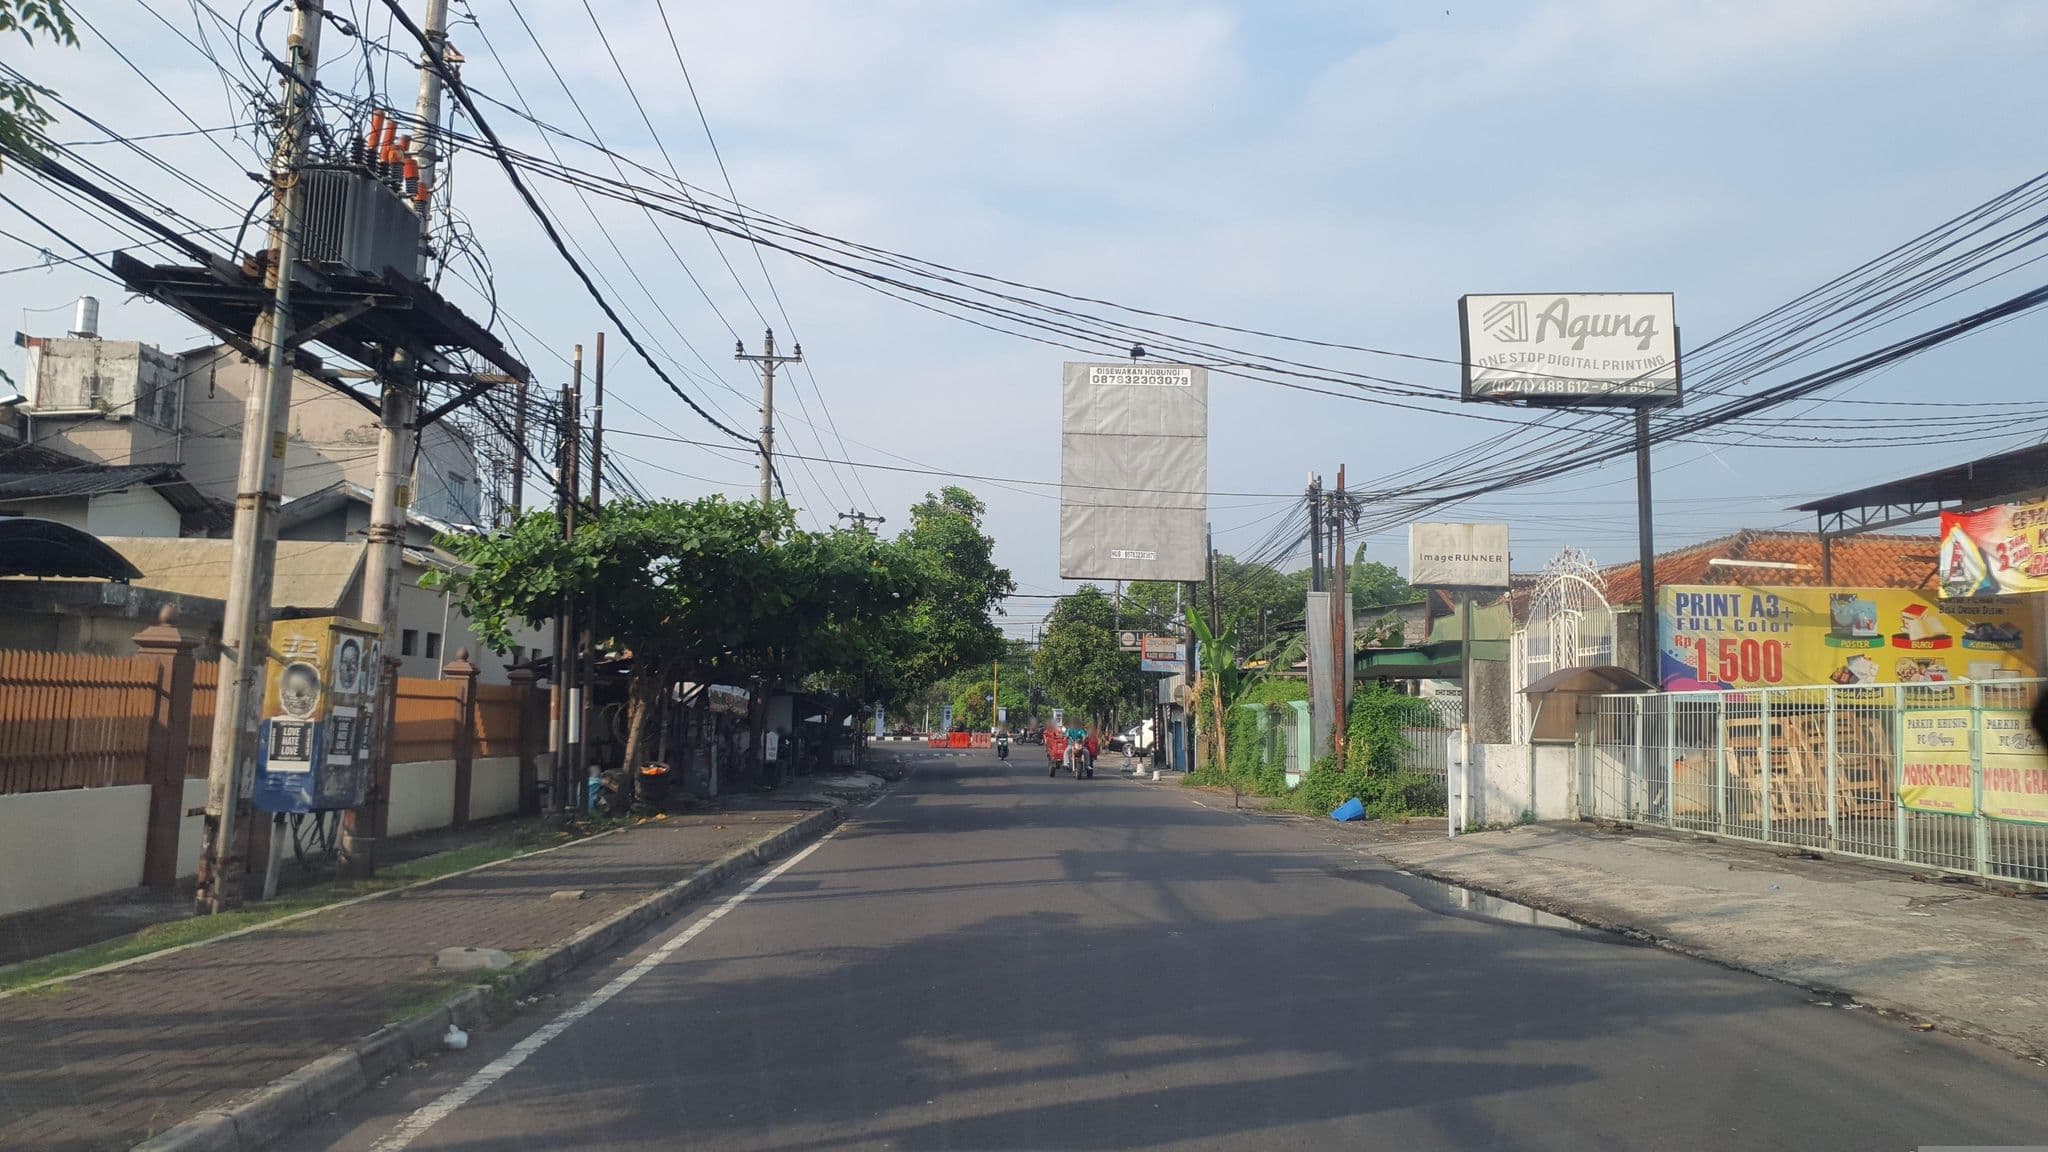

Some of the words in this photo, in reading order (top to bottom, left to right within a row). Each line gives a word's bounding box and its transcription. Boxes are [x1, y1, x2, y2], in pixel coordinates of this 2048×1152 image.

[1535, 297, 1659, 350] Agung
[1478, 353, 1507, 367] ONE
[1509, 352, 1545, 364] STOP
[1547, 354, 1600, 370] DIGITAL
[1605, 355, 1665, 371] PRINTING
[1097, 367, 1143, 375] DISEWAKAN
[1538, 380, 1567, 393] 488
[1567, 380, 1590, 393] 612
[1675, 593, 1741, 617] PRINT
[1750, 594, 1793, 618] A3+
[1677, 617, 1725, 631] FULL
[1734, 619, 1793, 632] Color
[1675, 634, 1692, 648] Rp
[1840, 640, 1870, 648] POSTER
[1911, 641, 1933, 649] BUKU
[1986, 719, 2020, 729] PARKIR
[283, 727, 301, 736] LOVE
[281, 746, 299, 755] LOVE
[1983, 768, 2021, 793] MOTOR
